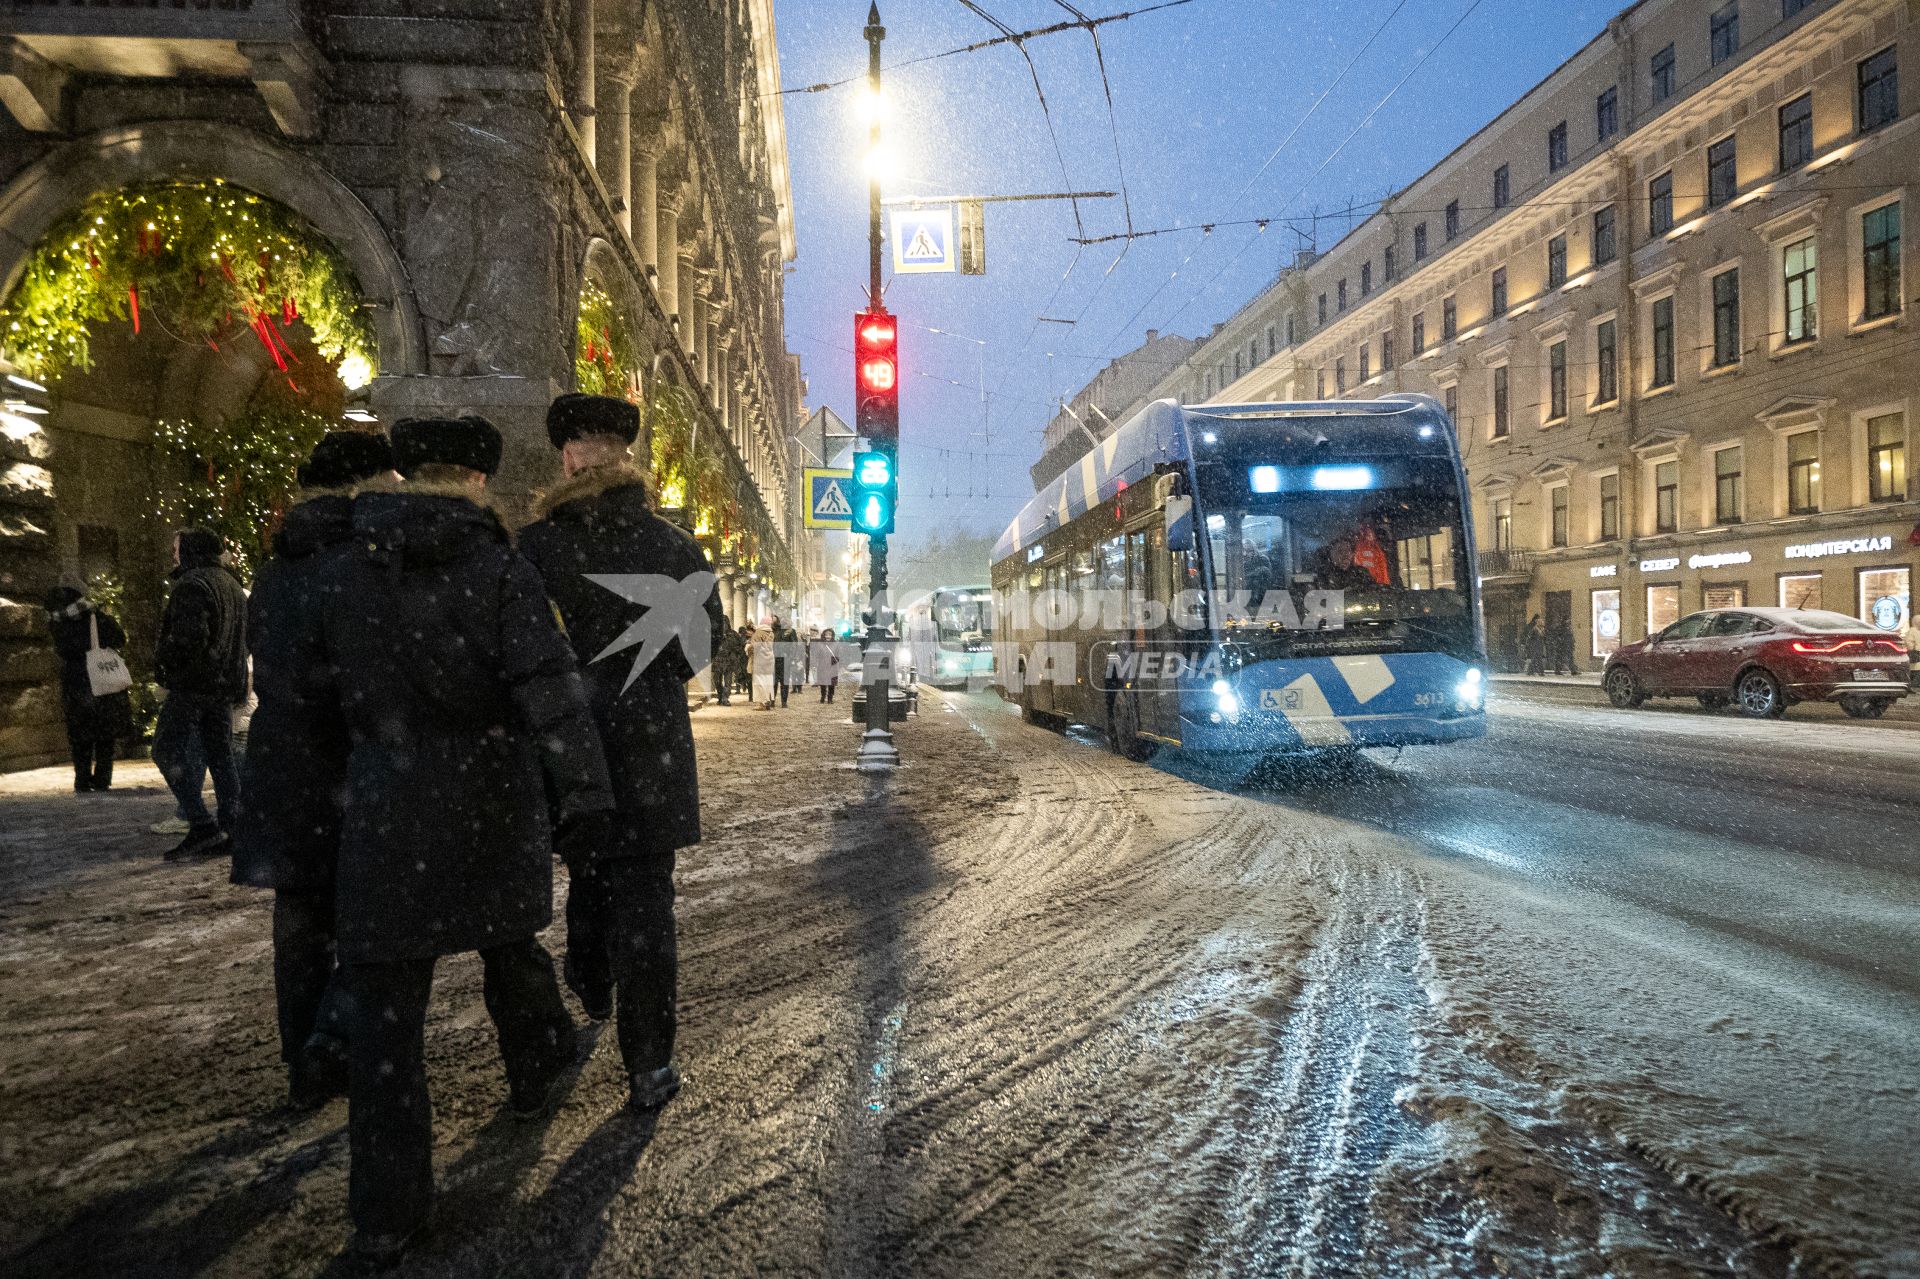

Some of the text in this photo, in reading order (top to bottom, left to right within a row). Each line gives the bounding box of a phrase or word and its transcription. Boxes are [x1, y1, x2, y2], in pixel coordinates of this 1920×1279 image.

[864, 362, 892, 388] 49
[1785, 536, 1892, 559] КОНДИТЕРСКАЯ
[1640, 558, 1680, 572] СЕВЕР
